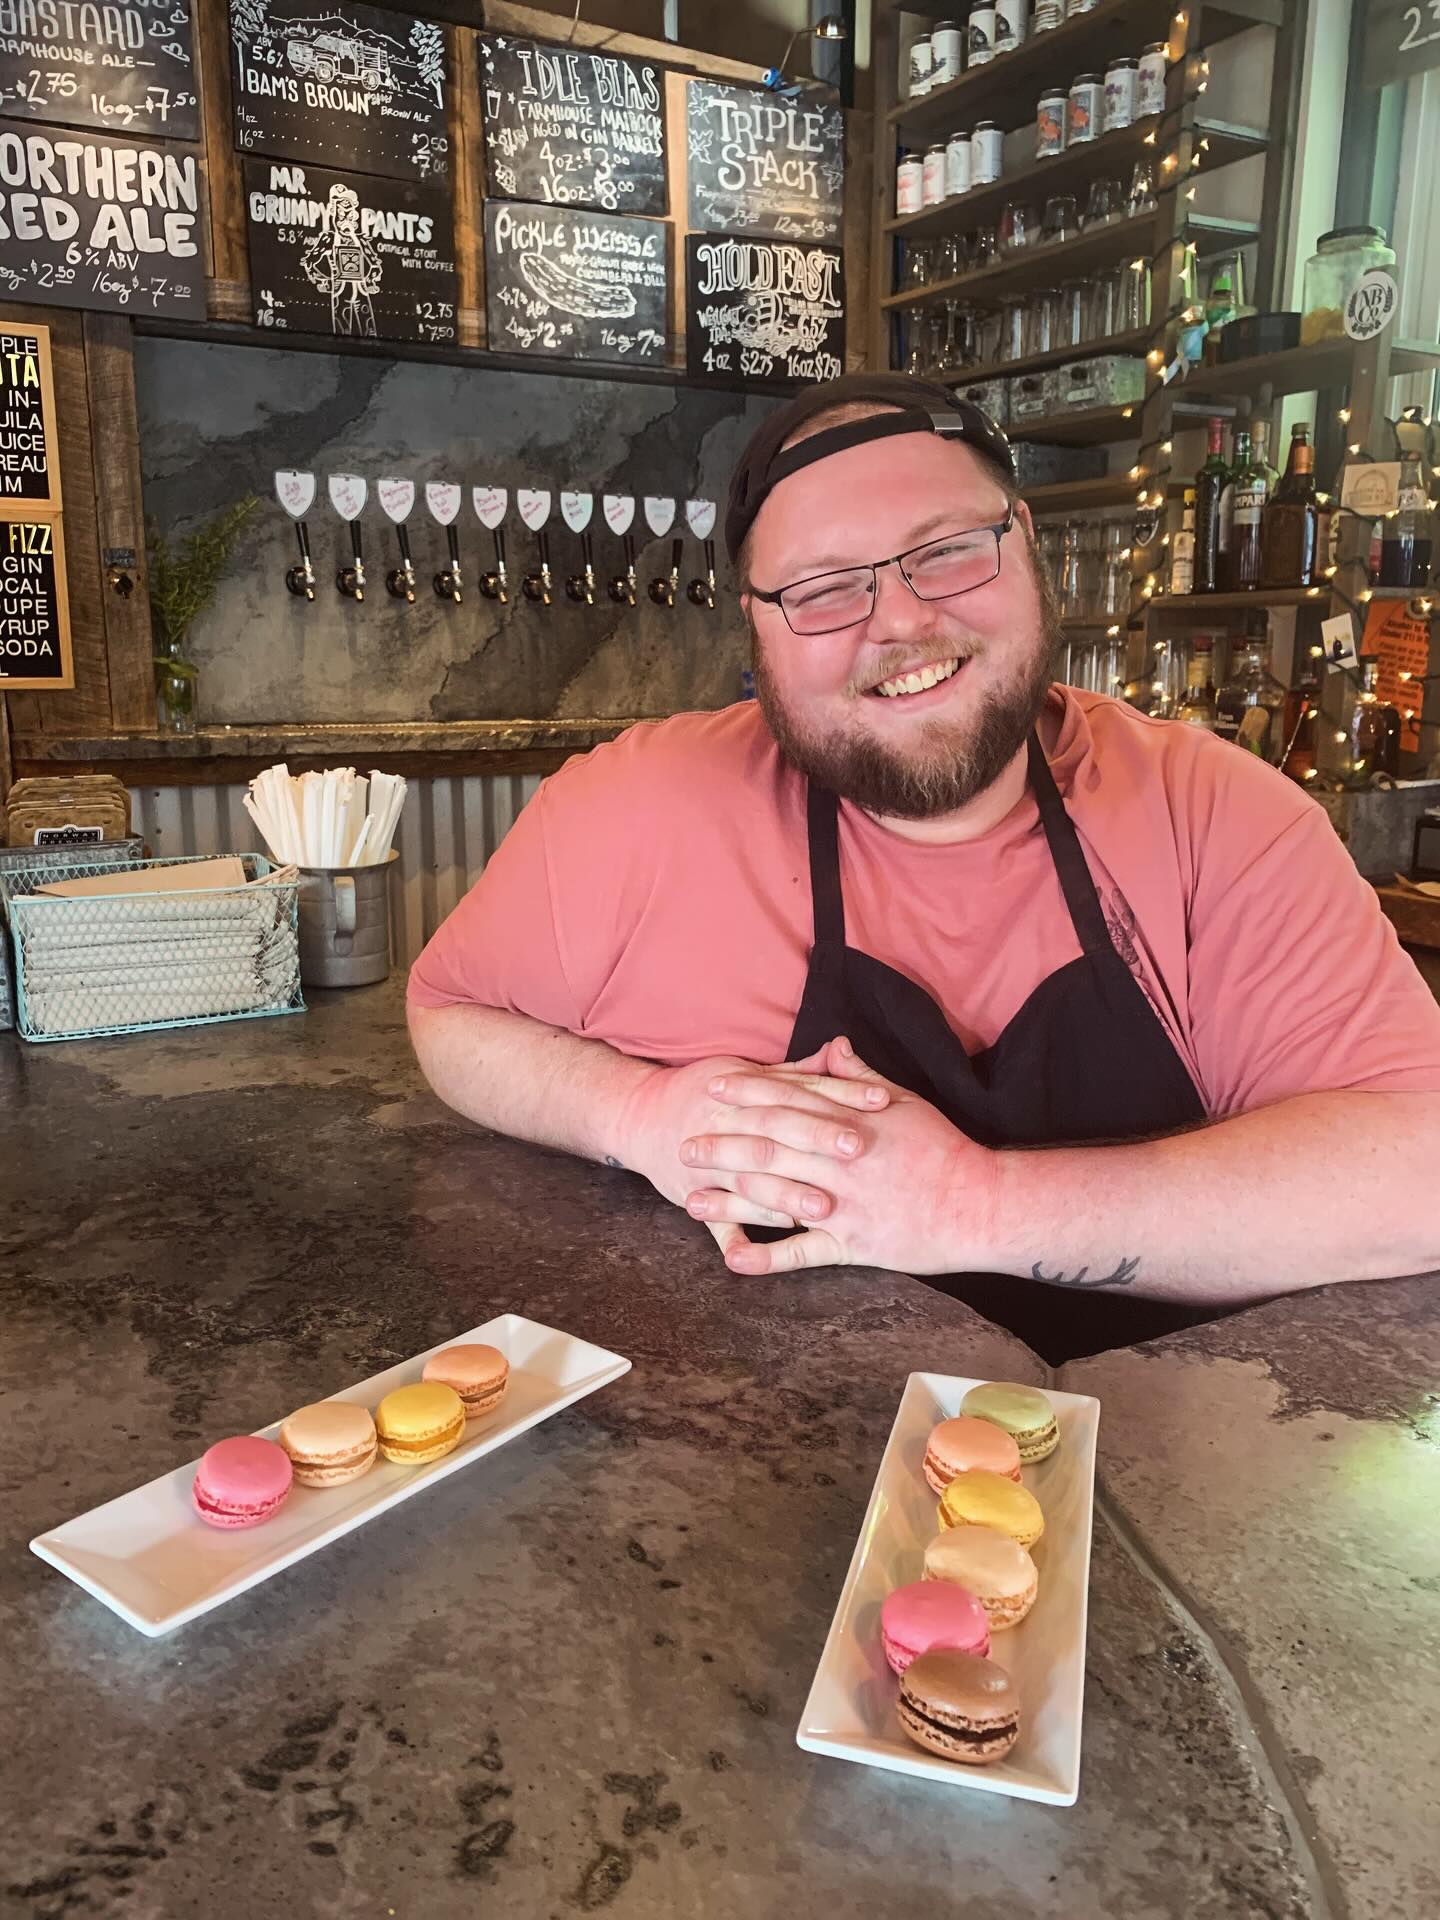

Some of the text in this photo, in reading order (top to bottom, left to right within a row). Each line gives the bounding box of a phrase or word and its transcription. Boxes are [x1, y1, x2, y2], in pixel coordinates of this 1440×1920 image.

[256, 35, 273, 47] ABV
[102, 58, 136, 68] ALE
[252, 45, 284, 69] 5.6%
[246, 68, 299, 102] BAM'S
[304, 82, 370, 116] BROWN
[517, 51, 660, 112] IDLE BIAS
[412, 111, 432, 122] ALE
[517, 100, 596, 126] FARMHOUSE
[533, 122, 562, 139] AGED
[565, 123, 578, 140] IN
[581, 128, 608, 145] GIN
[708, 98, 824, 153] TRIPLE
[240, 129, 265, 147] 16oz
[0, 131, 198, 212] ORTHERN
[270, 166, 311, 195] MR.
[718, 143, 820, 199] STACK
[250, 191, 434, 243] GRUMPY PANTS
[90, 204, 198, 257] ALE
[277, 228, 304, 245] 5.8%
[65, 241, 139, 271] 6% ABV
[402, 257, 454, 273] WITH COFFEE
[414, 248, 438, 259] STOUT
[1360, 288, 1382, 307] NB
[416, 302, 455, 320] $2.75
[1, 336, 38, 356] PLE
[0, 353, 40, 388] TA
[0, 432, 45, 452] UICE
[9, 523, 53, 555] FIZZ
[2, 556, 43, 574] GIN
[0, 577, 48, 596] CAL
